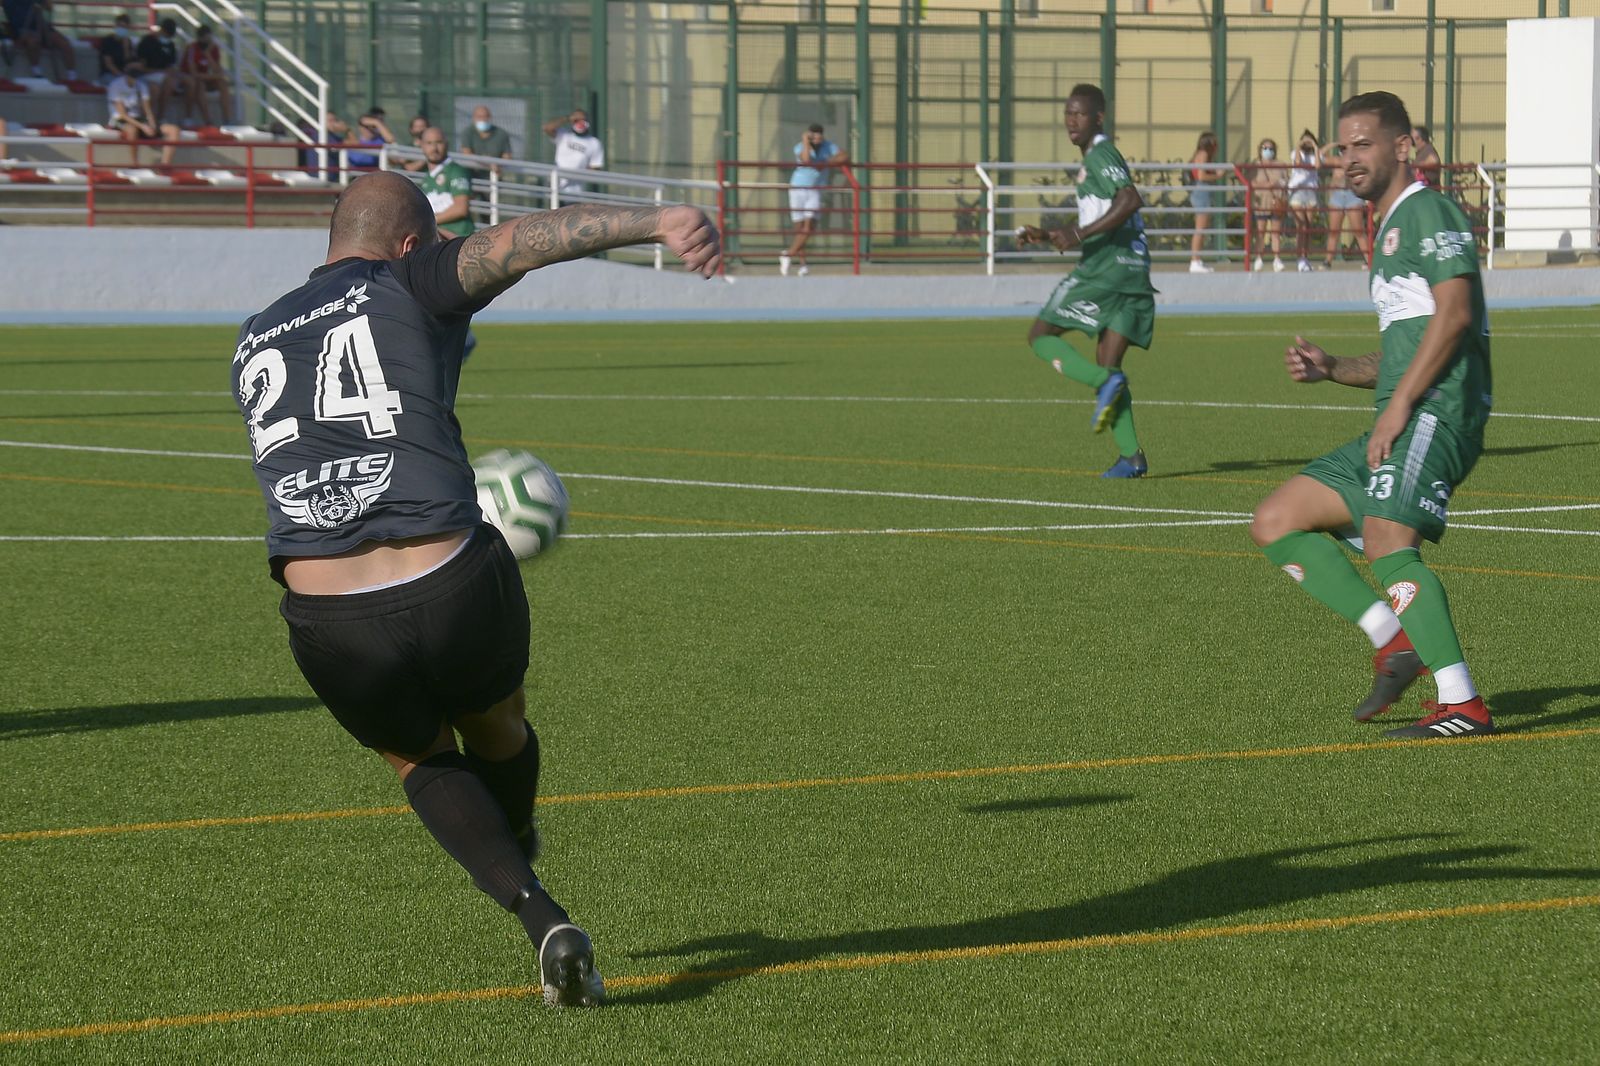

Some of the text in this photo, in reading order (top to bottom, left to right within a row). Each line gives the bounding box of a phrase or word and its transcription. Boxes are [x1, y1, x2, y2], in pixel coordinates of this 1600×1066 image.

[251, 296, 346, 350] PRIVILEGE
[238, 313, 403, 465] 24
[274, 452, 389, 497] ELITE
